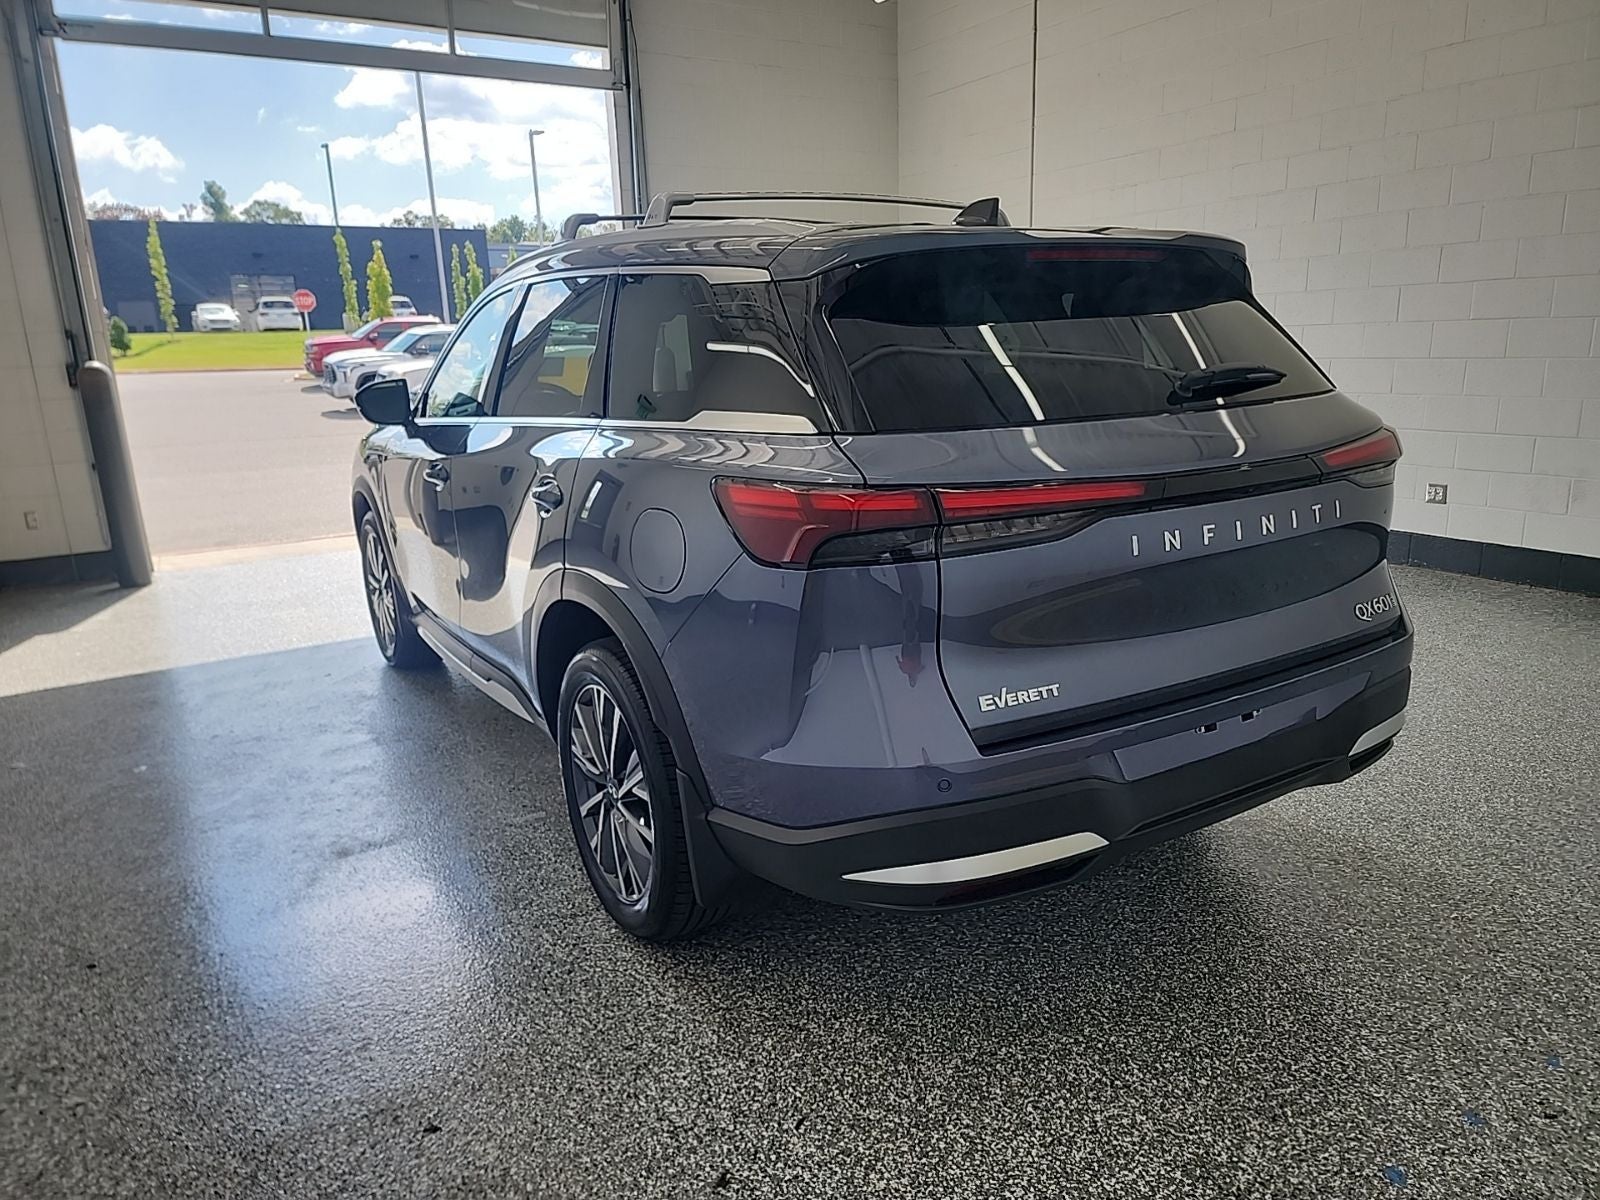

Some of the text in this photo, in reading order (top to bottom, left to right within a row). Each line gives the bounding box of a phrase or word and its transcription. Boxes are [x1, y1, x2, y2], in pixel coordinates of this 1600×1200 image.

[295, 296, 313, 306] STOP
[1131, 499, 1341, 556] INFINITI
[978, 683, 1060, 712] EVERETT
